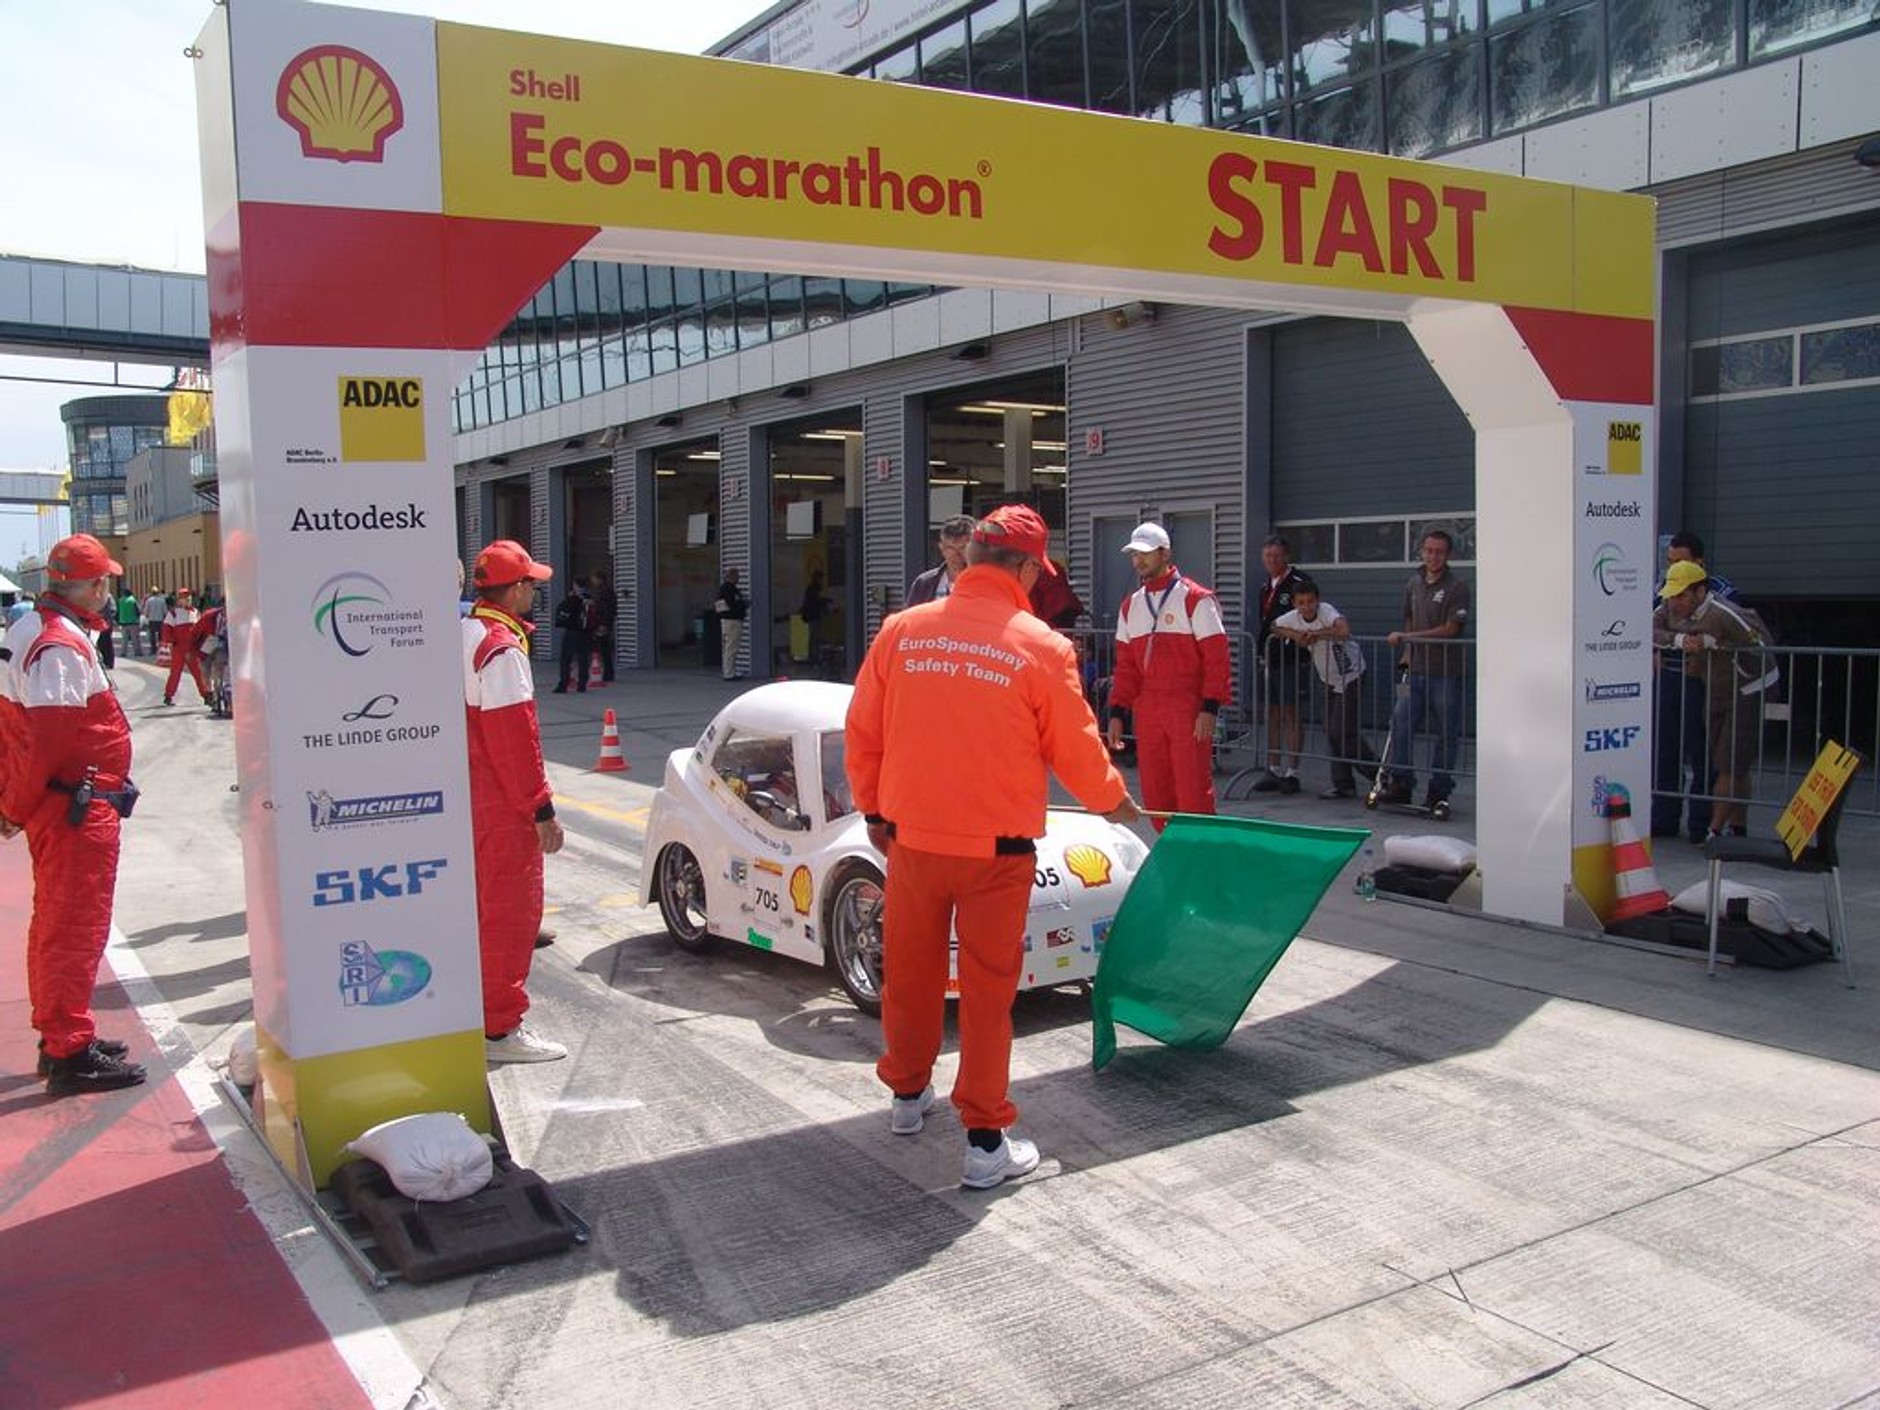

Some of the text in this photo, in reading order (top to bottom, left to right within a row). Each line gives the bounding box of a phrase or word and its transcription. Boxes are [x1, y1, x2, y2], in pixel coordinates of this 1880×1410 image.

[509, 69, 580, 102] Shell
[1207, 152, 1487, 282] START
[343, 379, 420, 408] ADAC
[1608, 422, 1641, 442] ADAC
[290, 503, 427, 532] Autodesk
[1585, 501, 1641, 518] Autodesk
[346, 609, 424, 624] International
[369, 623, 424, 636] Transport
[390, 637, 425, 648] Forum
[898, 636, 1028, 672] EuroSpeedway
[903, 657, 1012, 688] Safety Team
[302, 725, 441, 749] THE LINDE GROUP
[1584, 725, 1641, 752] SKF
[337, 795, 440, 817] MICHELIN
[313, 858, 448, 907] SKF
[1034, 867, 1061, 889] 05
[755, 886, 779, 912] 705
